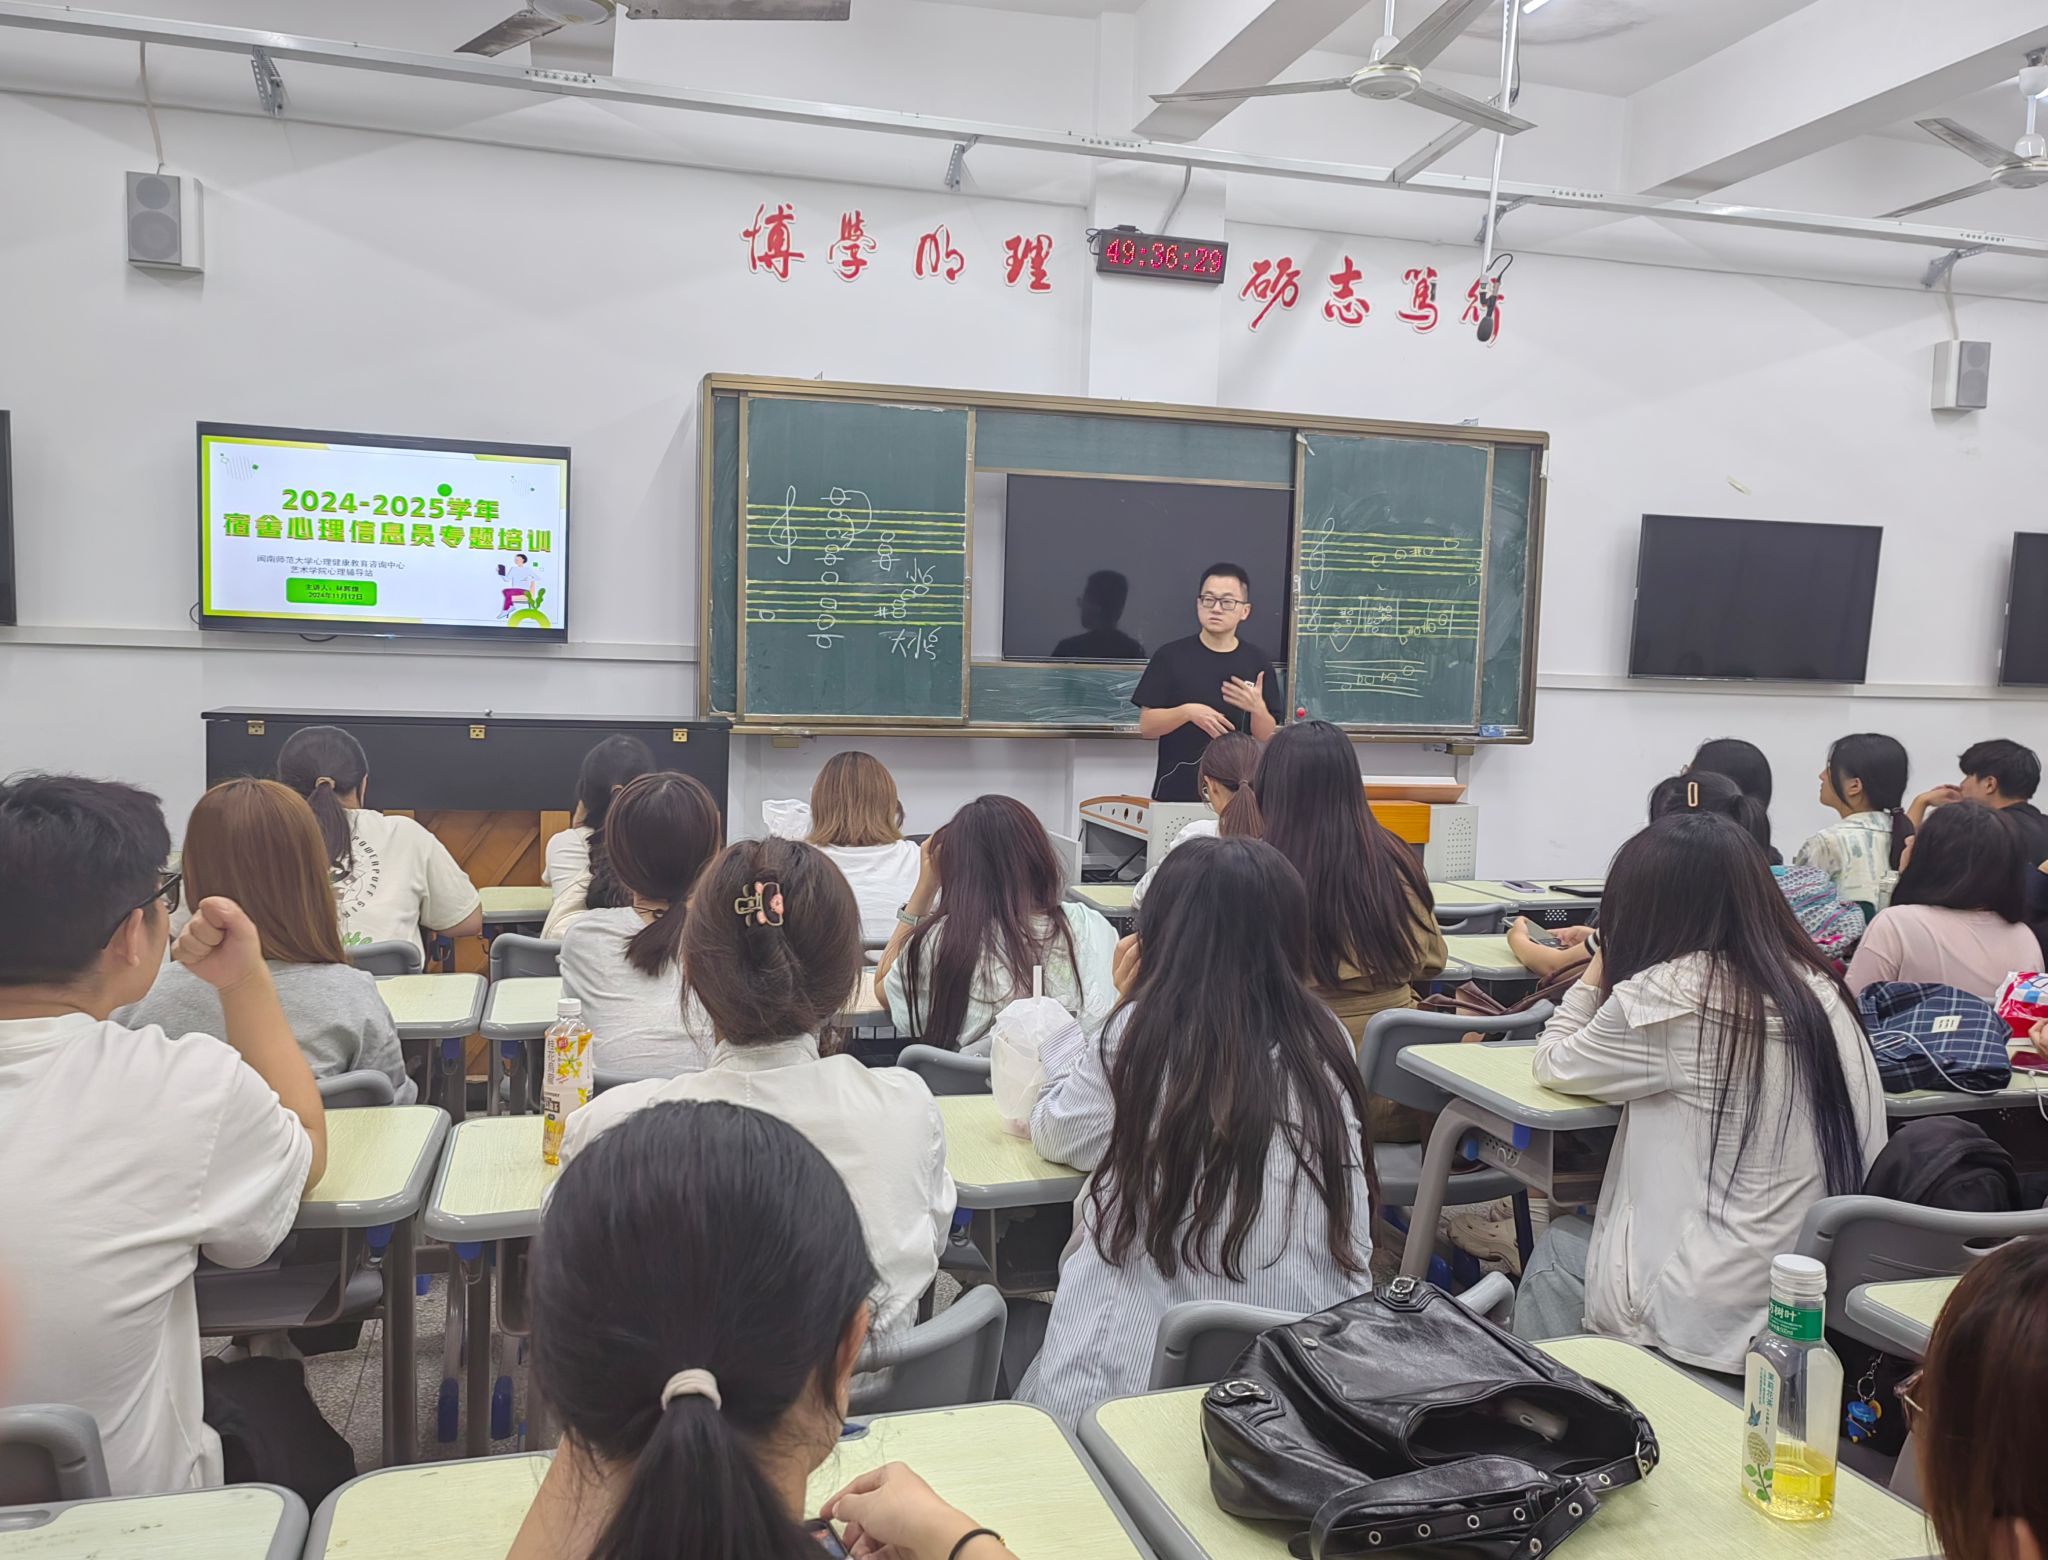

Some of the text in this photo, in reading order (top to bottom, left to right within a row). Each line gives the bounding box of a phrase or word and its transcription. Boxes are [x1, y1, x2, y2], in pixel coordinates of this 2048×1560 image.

[1106, 238, 1223, 274] 49:36:29
[281, 488, 500, 522] 2024-2025学年
[223, 512, 552, 553] 宿舍心理信息员专题培训
[256, 554, 406, 570] 闽南师范大学心理健康教育咨询中心
[290, 565, 374, 577] 艺术学院心理辅导站
[352, 835, 380, 897] POWERPUFF
